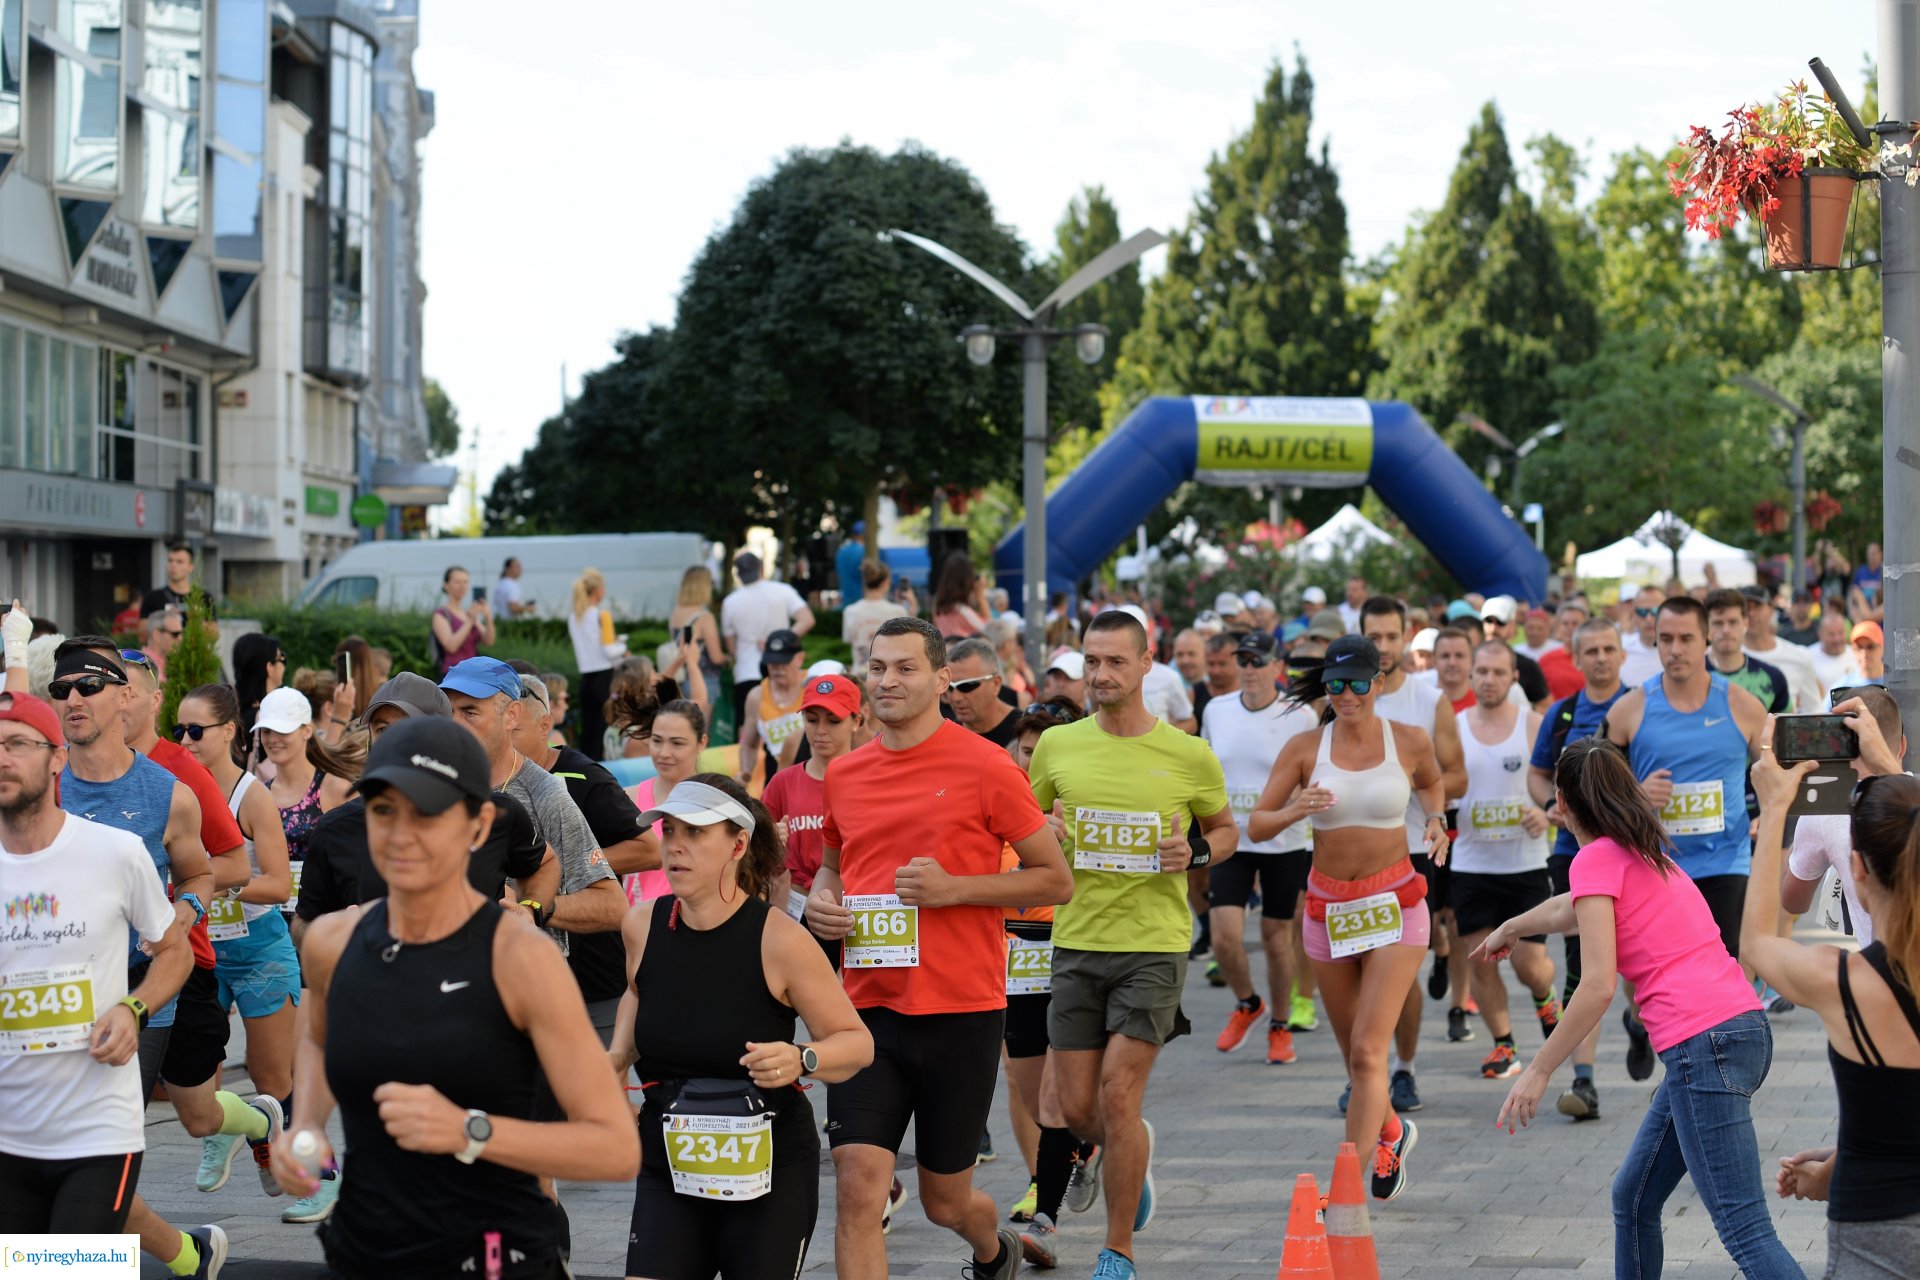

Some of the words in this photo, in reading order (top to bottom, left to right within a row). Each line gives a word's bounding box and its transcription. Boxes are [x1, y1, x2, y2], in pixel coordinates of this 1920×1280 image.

[1215, 429, 1354, 462] RAJT/CÉL
[1228, 794, 1255, 809] 40
[1663, 793, 1717, 814] 2124
[1475, 806, 1520, 823] 2304
[1082, 823, 1151, 847] 2182
[1357, 861, 1406, 894] NIKE
[208, 900, 234, 918] 51
[1332, 906, 1394, 934] 2313
[1012, 950, 1053, 970] 223
[0, 984, 83, 1019] 2349
[675, 1135, 762, 1164] 2347
